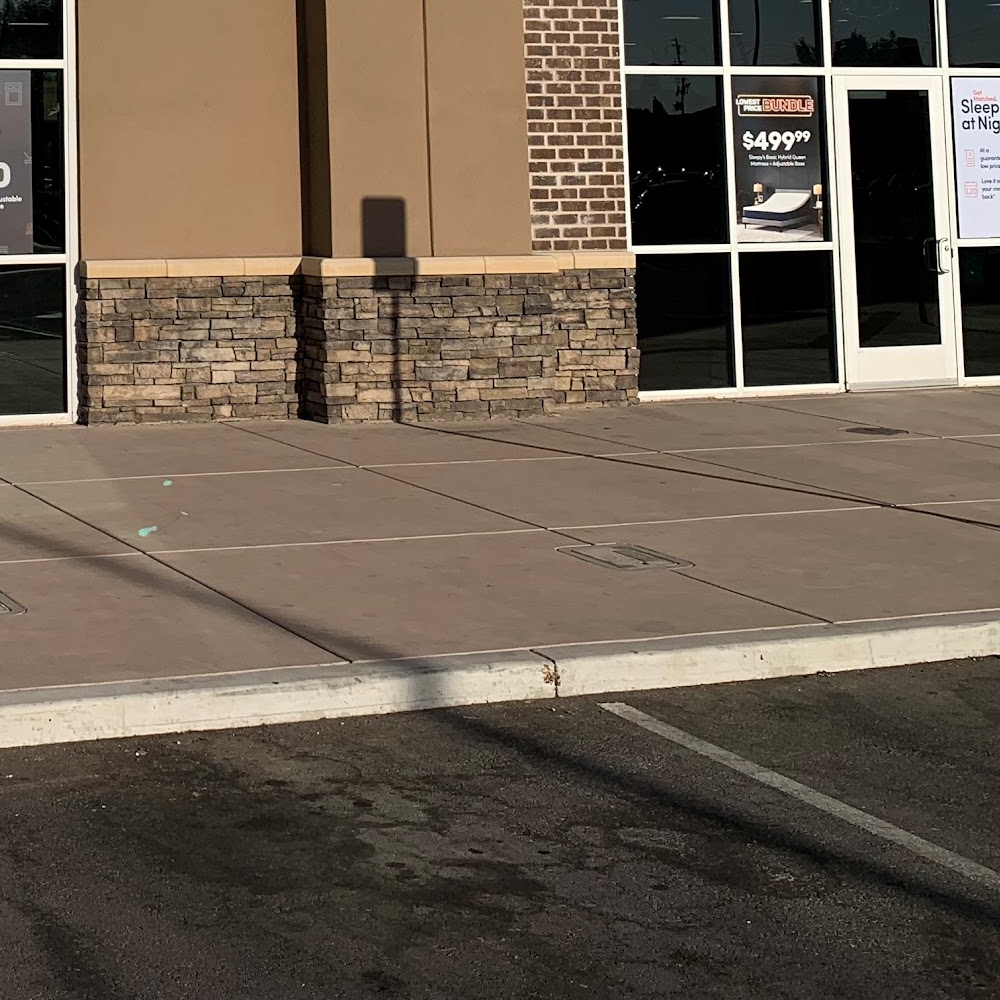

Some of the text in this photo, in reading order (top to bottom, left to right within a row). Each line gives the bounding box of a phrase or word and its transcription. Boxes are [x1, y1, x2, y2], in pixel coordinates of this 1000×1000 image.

[735, 98, 761, 106] LOWEST
[762, 98, 815, 113] BUNDLE
[962, 117, 975, 130] at
